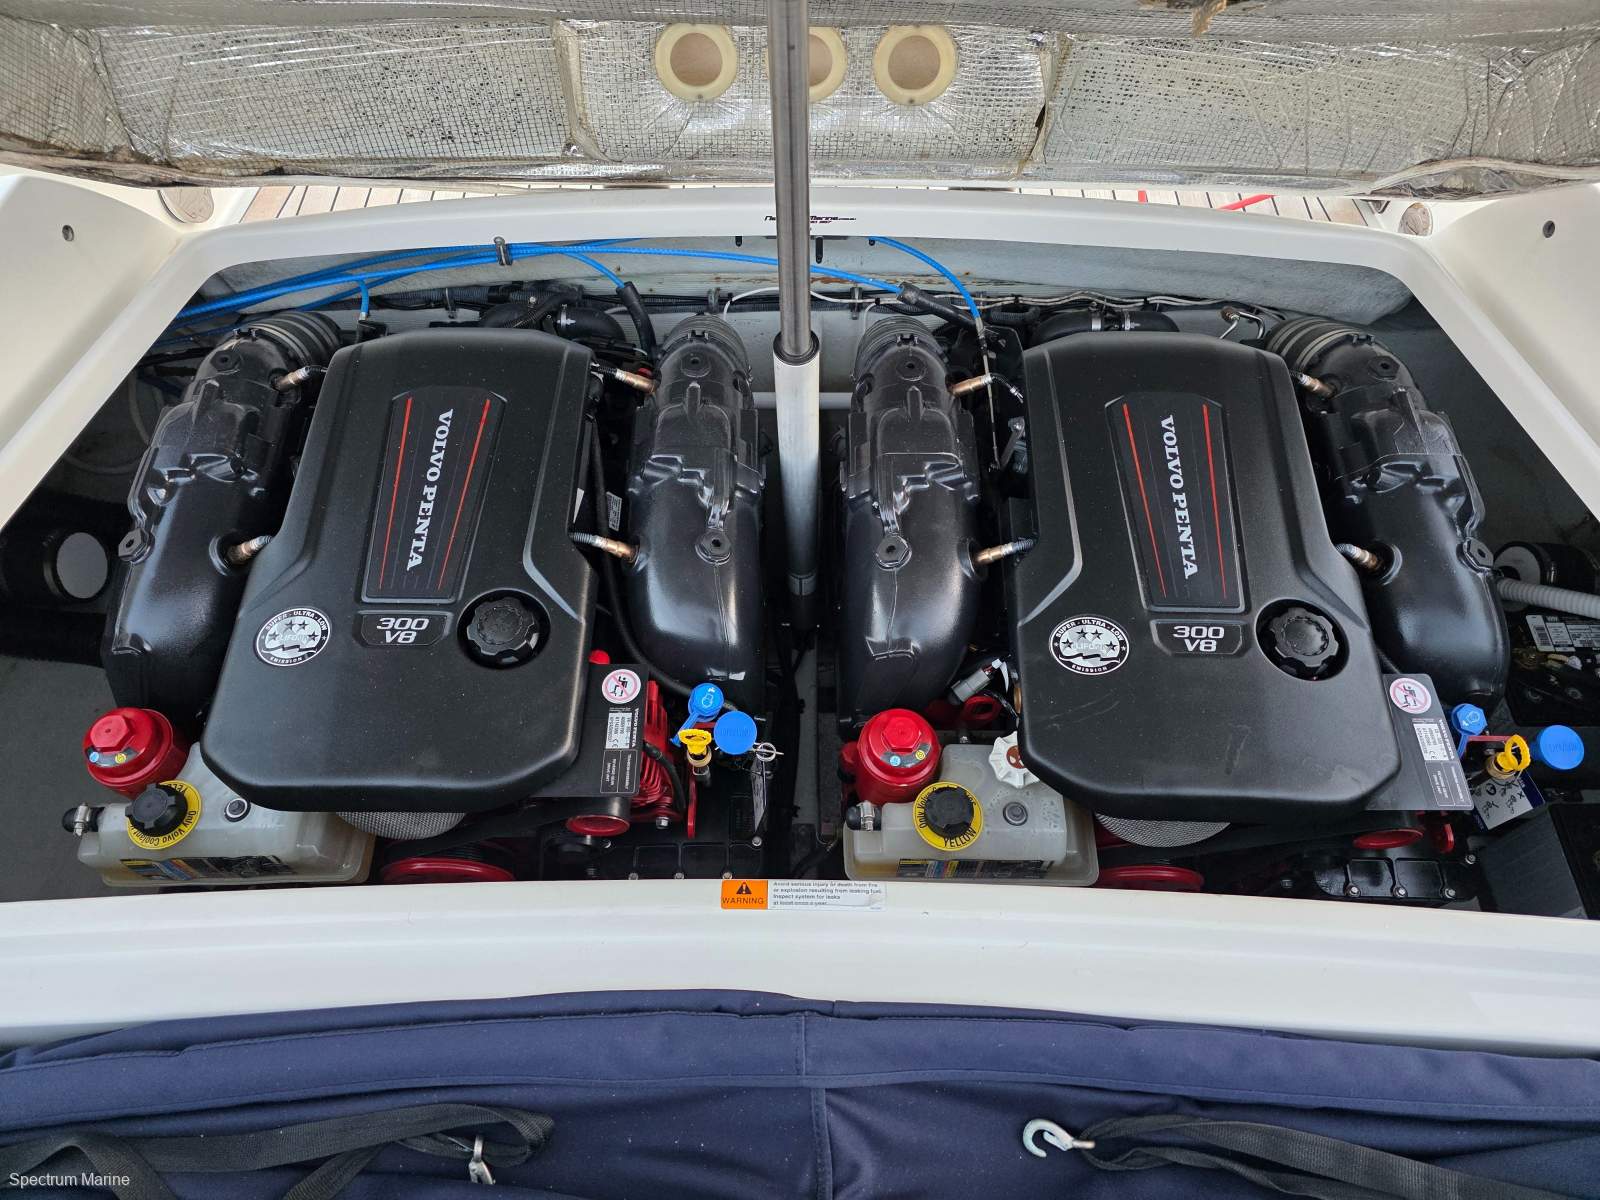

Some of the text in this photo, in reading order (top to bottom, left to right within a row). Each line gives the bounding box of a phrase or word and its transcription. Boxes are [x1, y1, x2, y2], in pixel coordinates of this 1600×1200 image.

[407, 409, 454, 572] VOLVO PENTA
[1161, 415, 1199, 580] VOLVO PENTA
[377, 618, 430, 631] 300
[1056, 622, 1077, 638] SUPER
[1081, 620, 1106, 628] ULTRA
[385, 631, 418, 644] V8
[1173, 626, 1225, 639] 300
[1184, 640, 1217, 652] V8
[183, 811, 197, 828] Only
[163, 829, 185, 844] Volvo
[944, 827, 977, 847] YELLOW
[722, 897, 764, 905] WARNING
